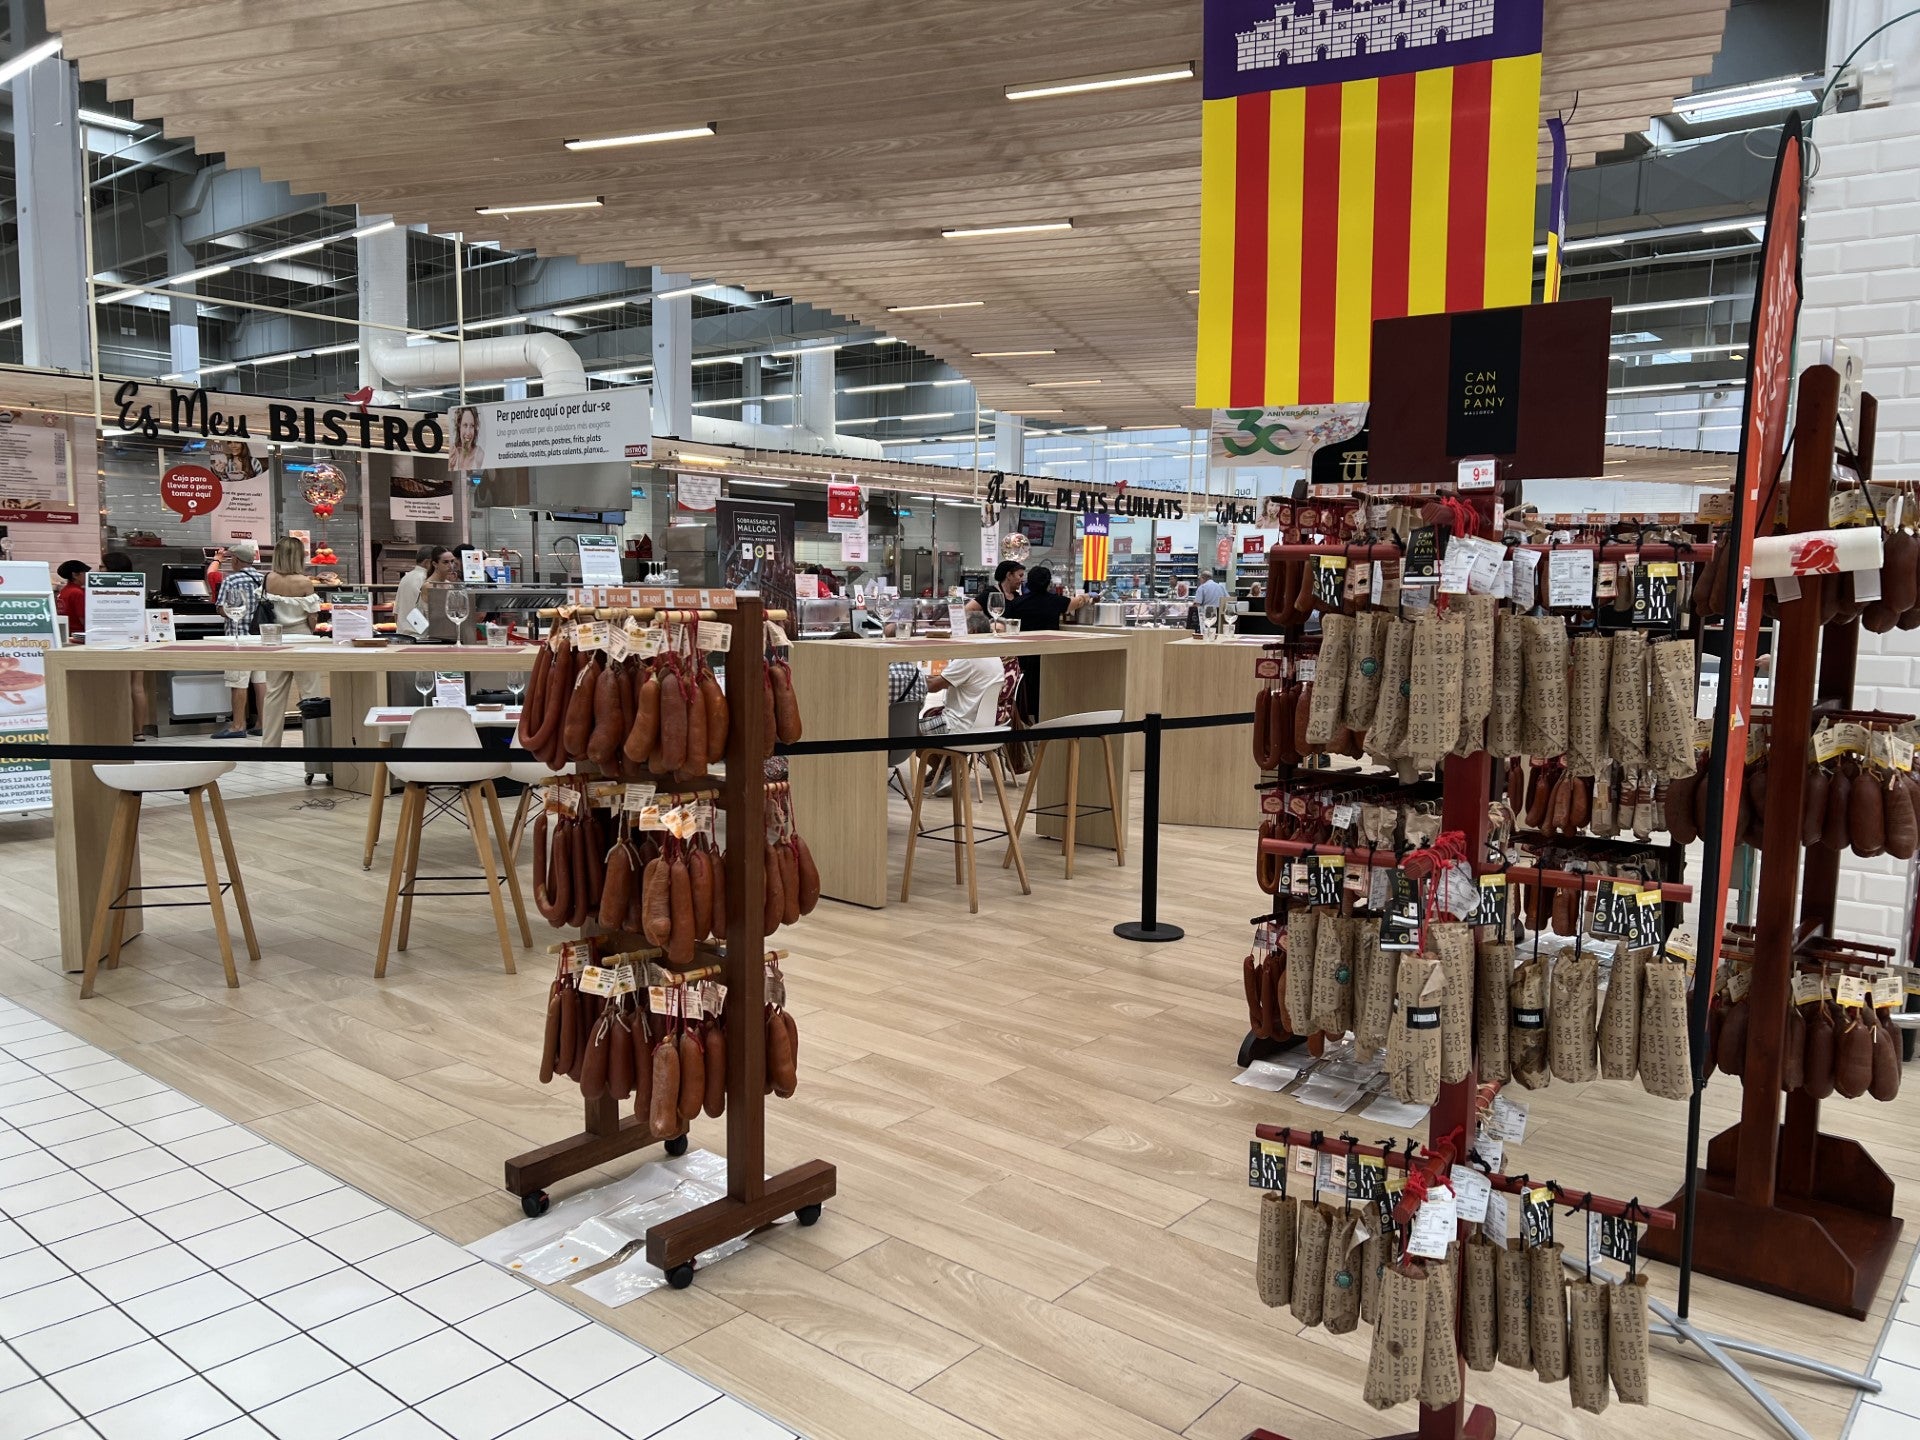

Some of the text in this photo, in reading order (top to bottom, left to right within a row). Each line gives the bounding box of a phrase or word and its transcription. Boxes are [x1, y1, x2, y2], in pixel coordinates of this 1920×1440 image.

[1466, 371, 1496, 382] CAN
[1465, 385, 1496, 395] COM
[1465, 397, 1504, 408] PANY
[115, 381, 443, 454] Es Meu BISTRÓ
[497, 410, 509, 420] Per
[511, 406, 538, 423] pendre
[540, 403, 558, 420] aquí
[567, 405, 580, 418] per
[582, 401, 610, 413] dur-se
[552, 437, 572, 446] postres,
[587, 434, 601, 443] plats
[548, 449, 561, 458] plats
[1056, 488, 1108, 514] PLATS
[1115, 494, 1183, 520] CUINATS
[737, 525, 776, 533] MALLORCA
